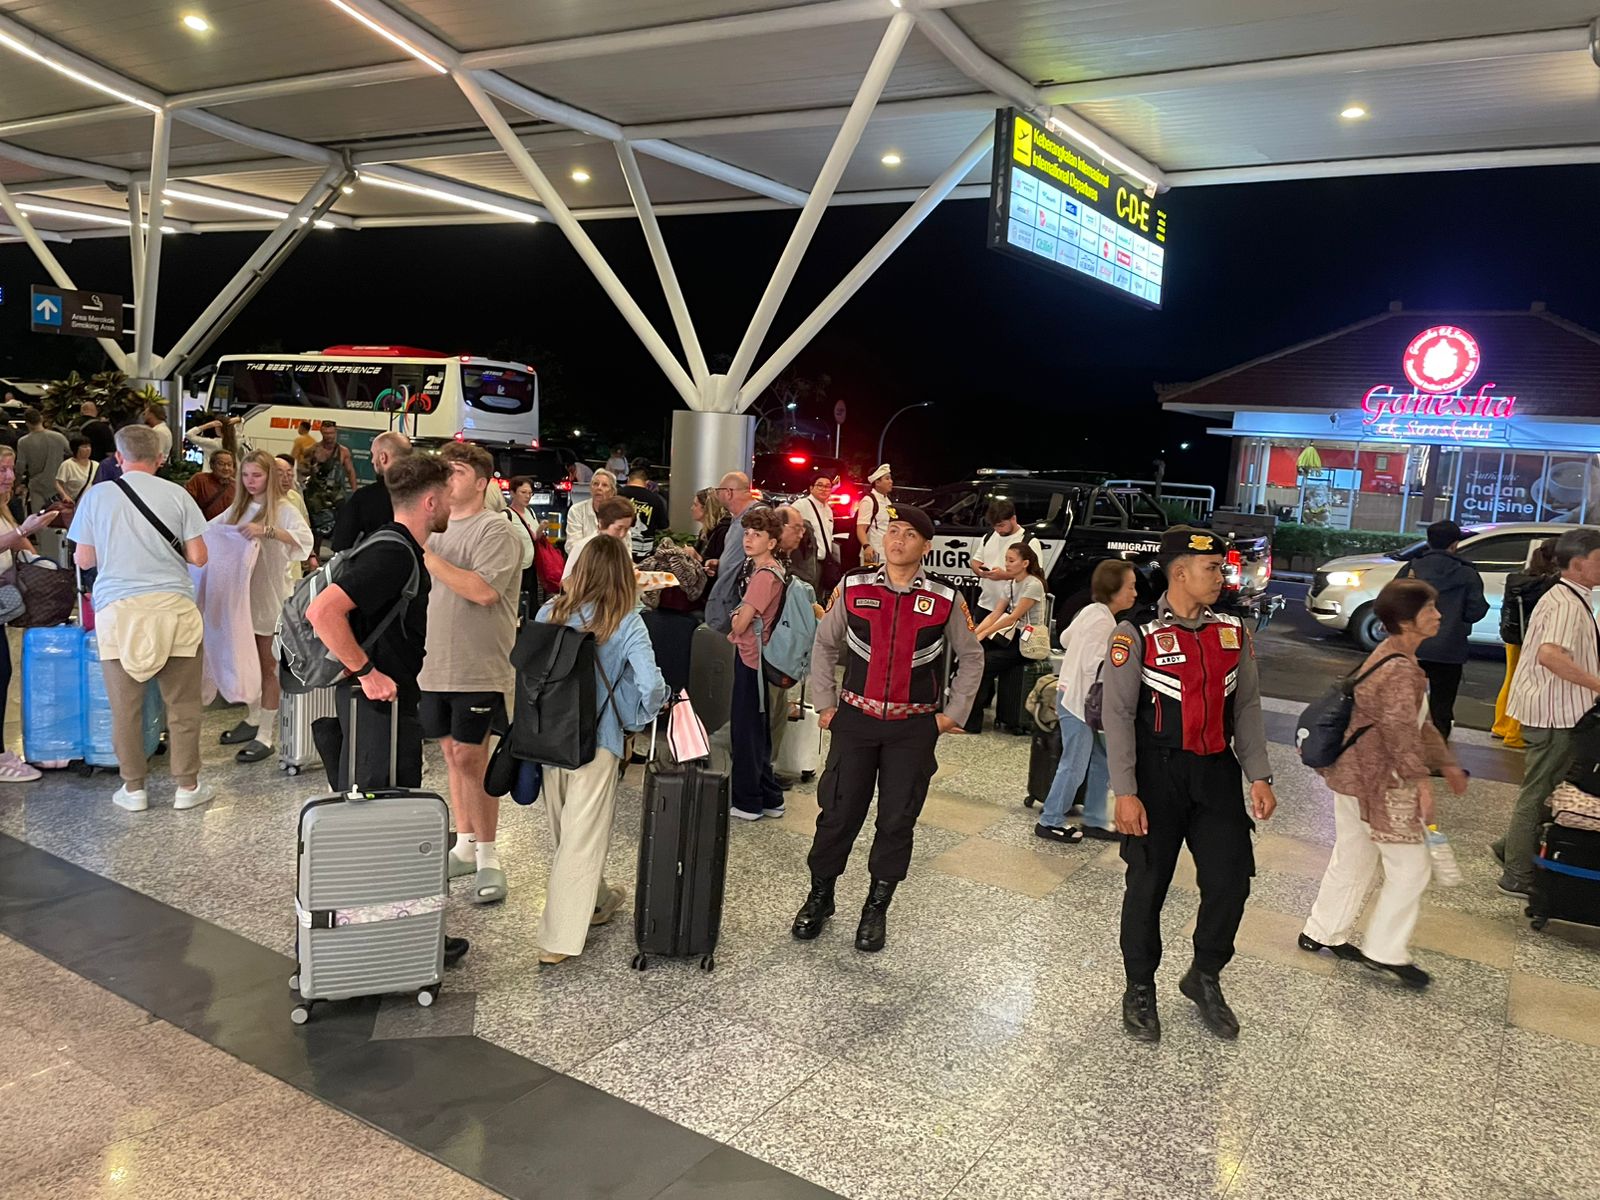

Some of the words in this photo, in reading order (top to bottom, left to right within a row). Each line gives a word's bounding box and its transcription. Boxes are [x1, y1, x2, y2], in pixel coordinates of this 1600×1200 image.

[1034, 127, 1078, 168] Keberangkatan
[1032, 150, 1070, 185] International
[1069, 172, 1099, 202] Departures
[71, 313, 87, 321] Area
[87, 315, 115, 324] Merokok
[71, 320, 99, 331] Smoking
[265, 363, 292, 371] BEST
[317, 365, 382, 374] EXPERIENCE
[1361, 383, 1516, 425] Ganesha
[1466, 470, 1520, 481] Authntic
[1466, 482, 1526, 498] Indan
[1463, 497, 1534, 514] Cuisine
[921, 549, 971, 568] MIGR
